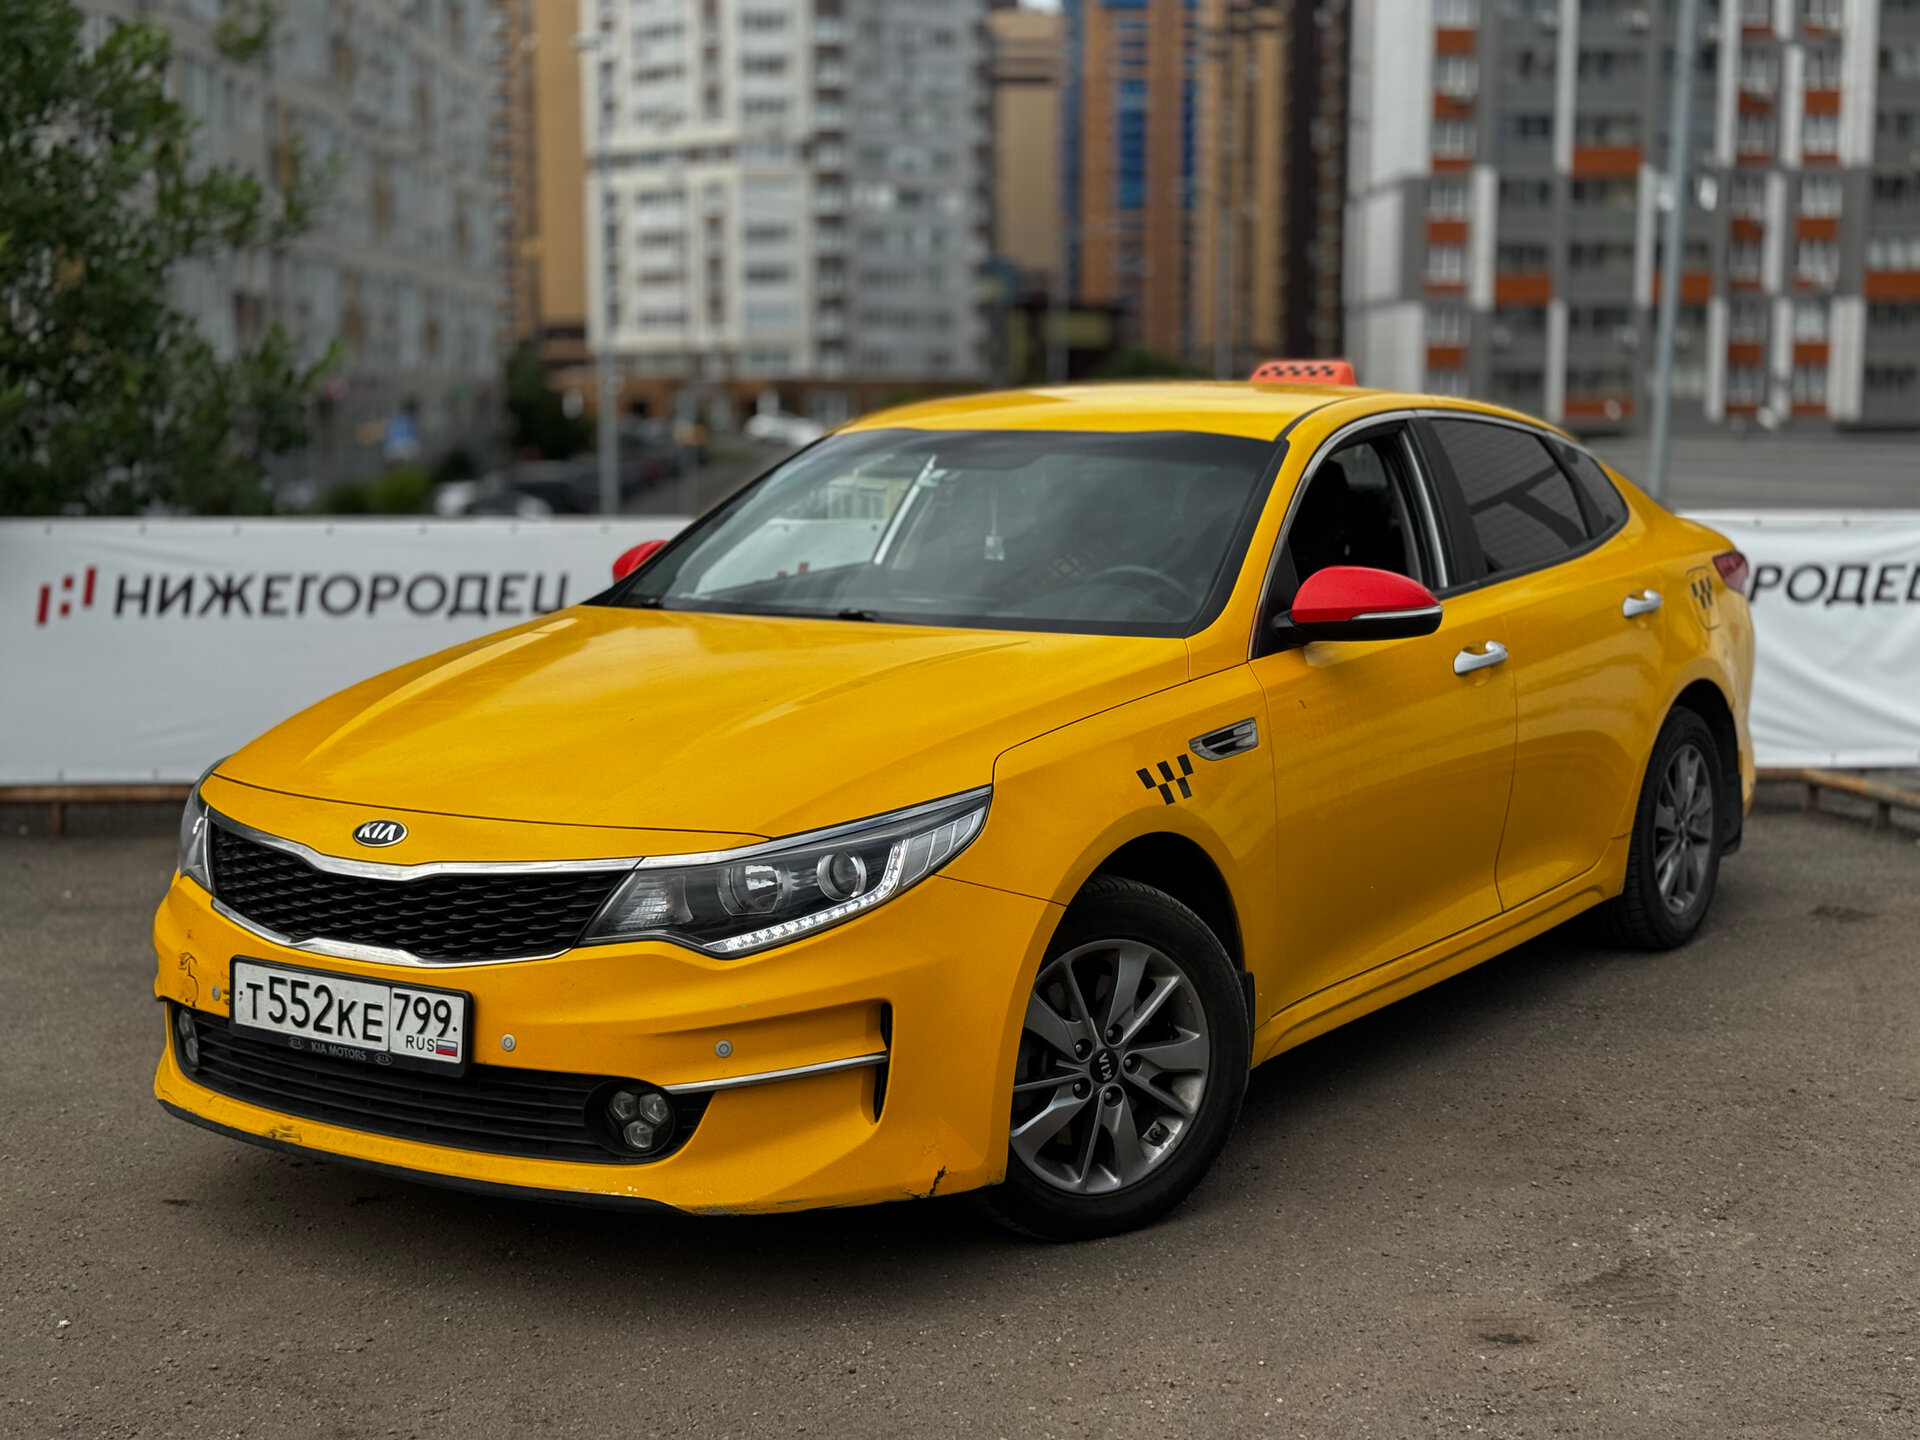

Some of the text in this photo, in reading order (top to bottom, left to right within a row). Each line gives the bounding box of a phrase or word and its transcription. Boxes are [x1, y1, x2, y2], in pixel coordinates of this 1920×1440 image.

[115, 570, 568, 617] НИЖЕГОРОДЕЦ
[358, 822, 397, 841] KIA
[394, 992, 451, 1037] 799
[311, 1042, 367, 1061] KIA MOTORS
[405, 1035, 435, 1052] RUS
[1099, 1052, 1112, 1080] KIA
